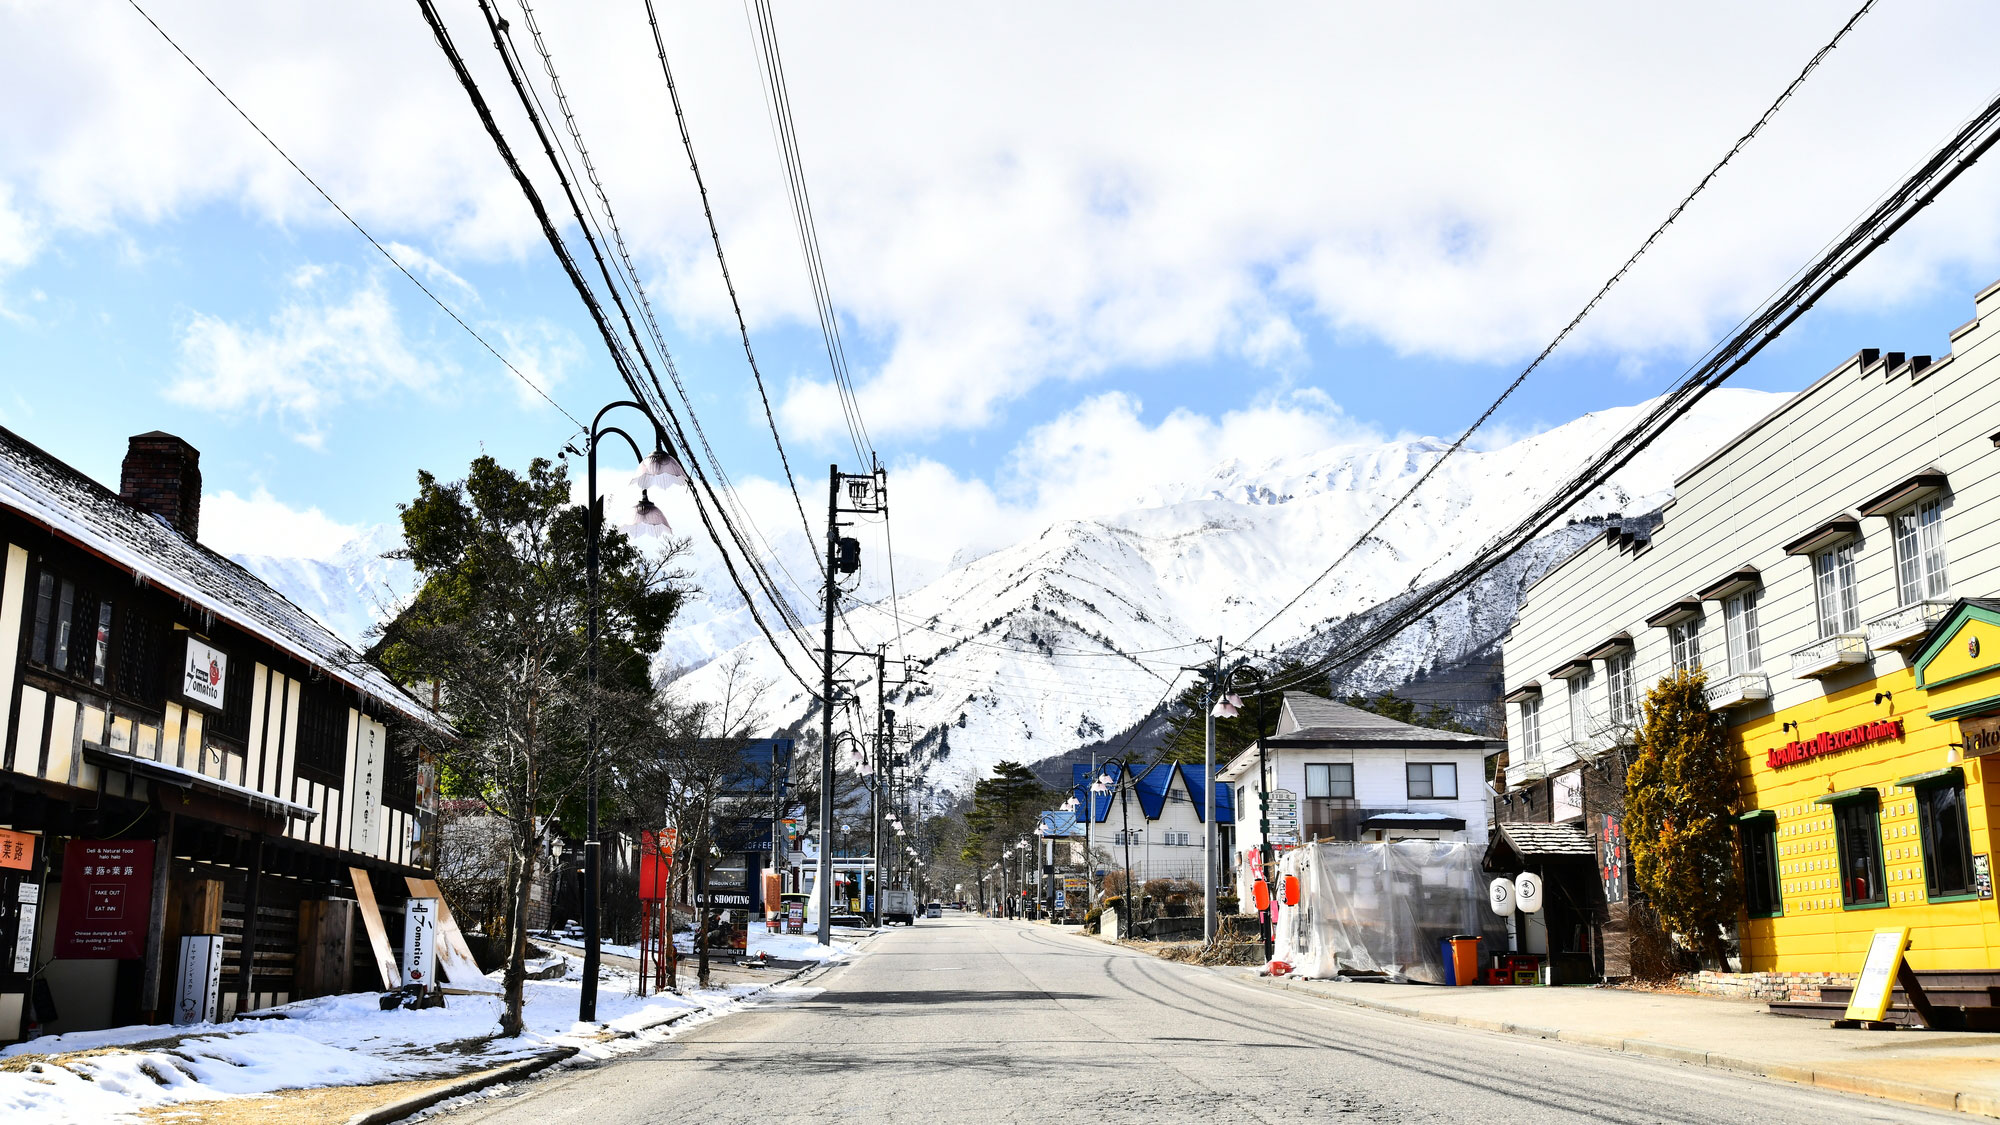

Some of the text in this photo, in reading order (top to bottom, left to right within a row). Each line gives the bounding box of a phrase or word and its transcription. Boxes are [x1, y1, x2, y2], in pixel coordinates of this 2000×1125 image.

[186, 672, 217, 699] Tomatito
[1809, 739, 1817, 756] &
[1816, 726, 1866, 753] MEXICAN
[1866, 722, 1898, 740] dining
[714, 894, 750, 904] SHOOTING
[414, 915, 427, 966] Tomatito
